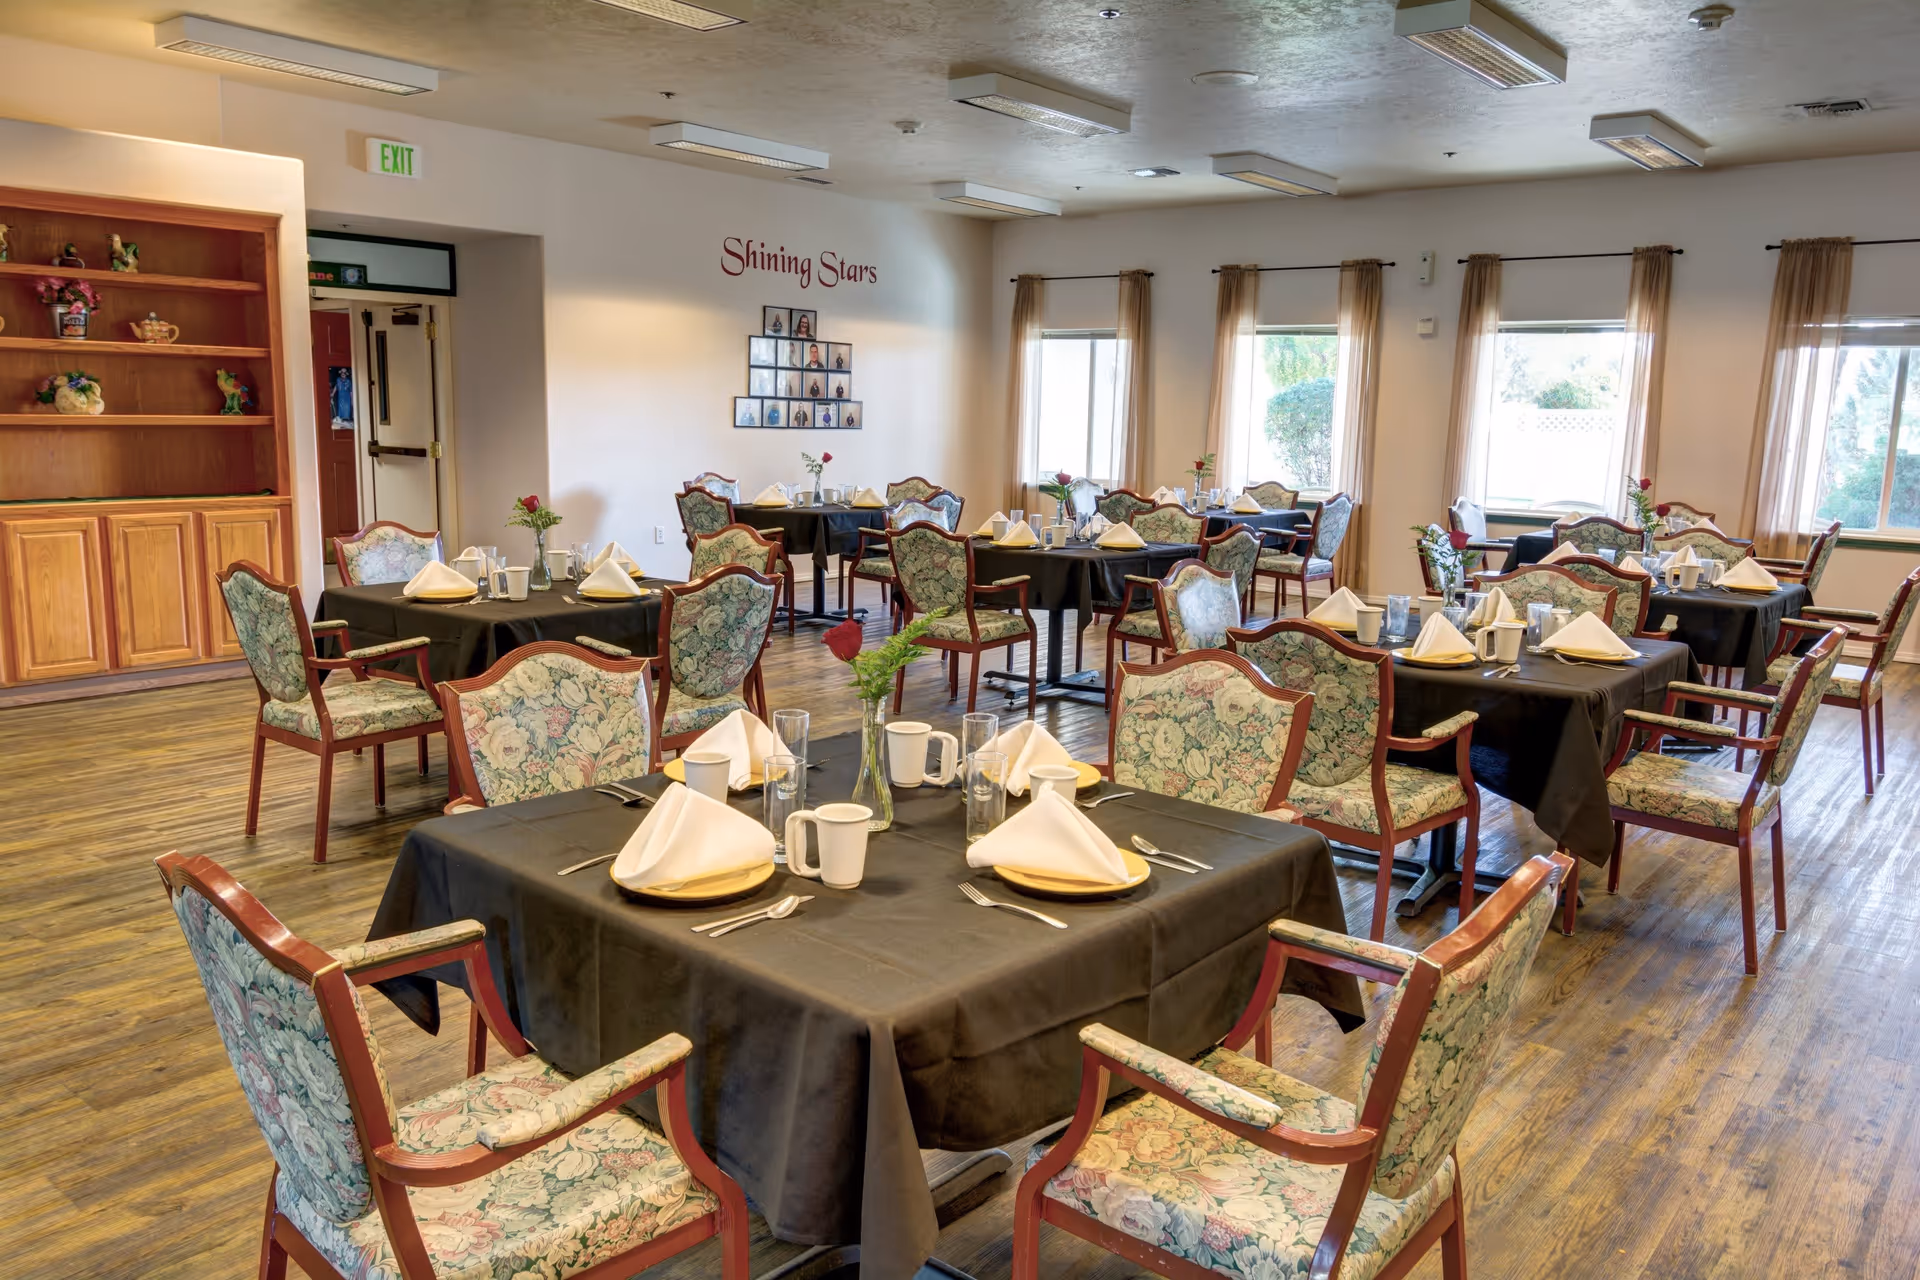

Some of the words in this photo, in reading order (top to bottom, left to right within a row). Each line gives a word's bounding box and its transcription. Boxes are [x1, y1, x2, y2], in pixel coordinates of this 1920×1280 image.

[381, 143, 414, 176] EXIT
[309, 271, 334, 281] ane
[721, 236, 811, 289] Shining
[818, 251, 877, 288] Stars
